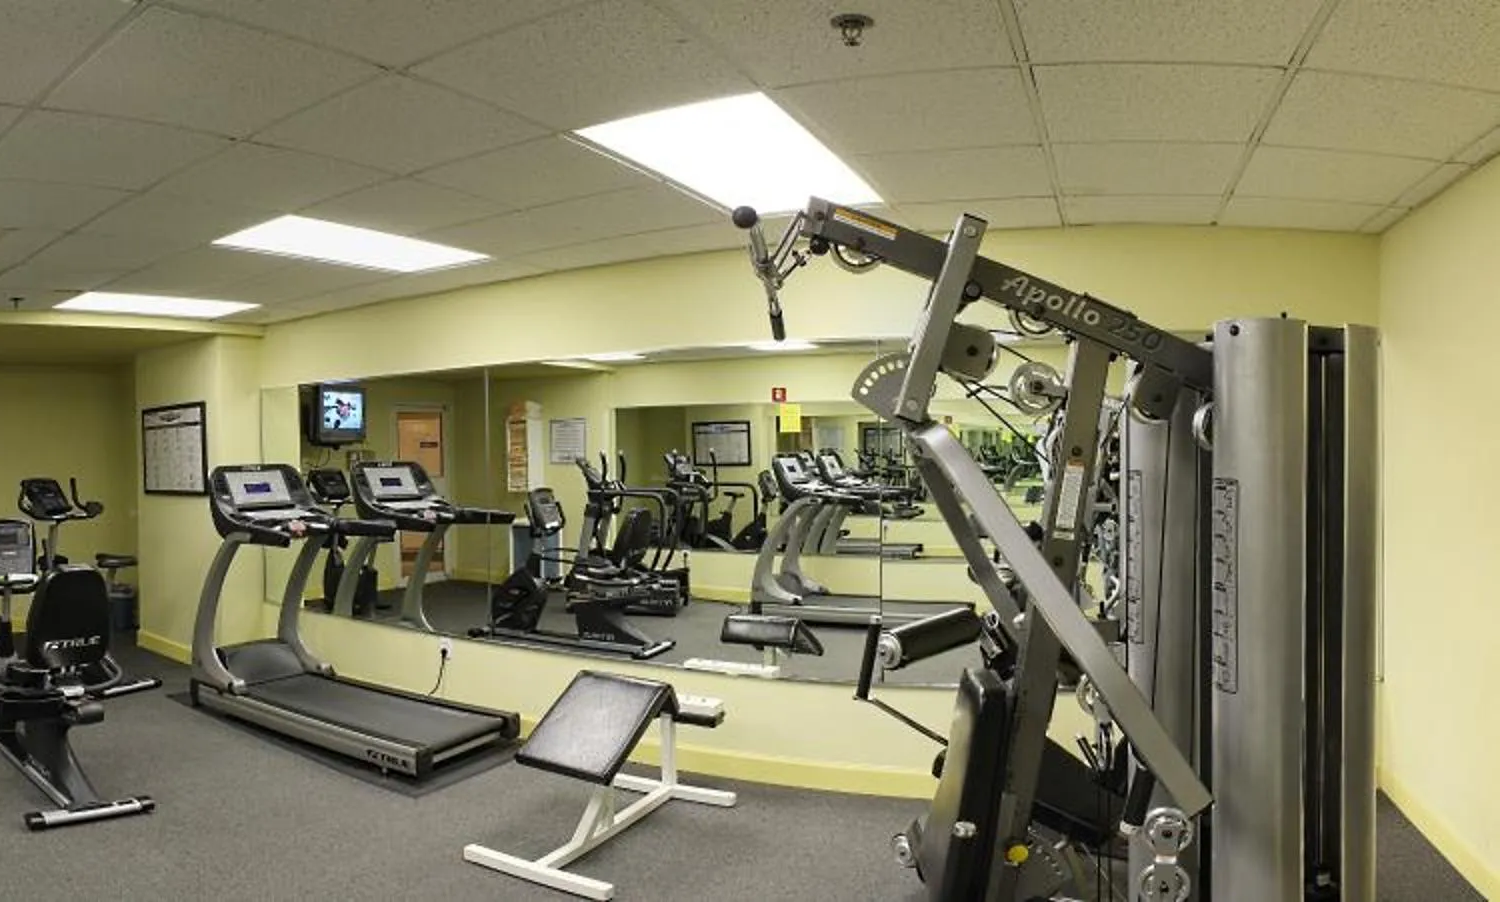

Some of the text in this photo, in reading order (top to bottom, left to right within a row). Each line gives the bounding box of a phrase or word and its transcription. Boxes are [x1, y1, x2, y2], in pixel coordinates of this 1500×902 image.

[1002, 275, 1163, 350] Apollo 250
[60, 635, 101, 649] TRUE
